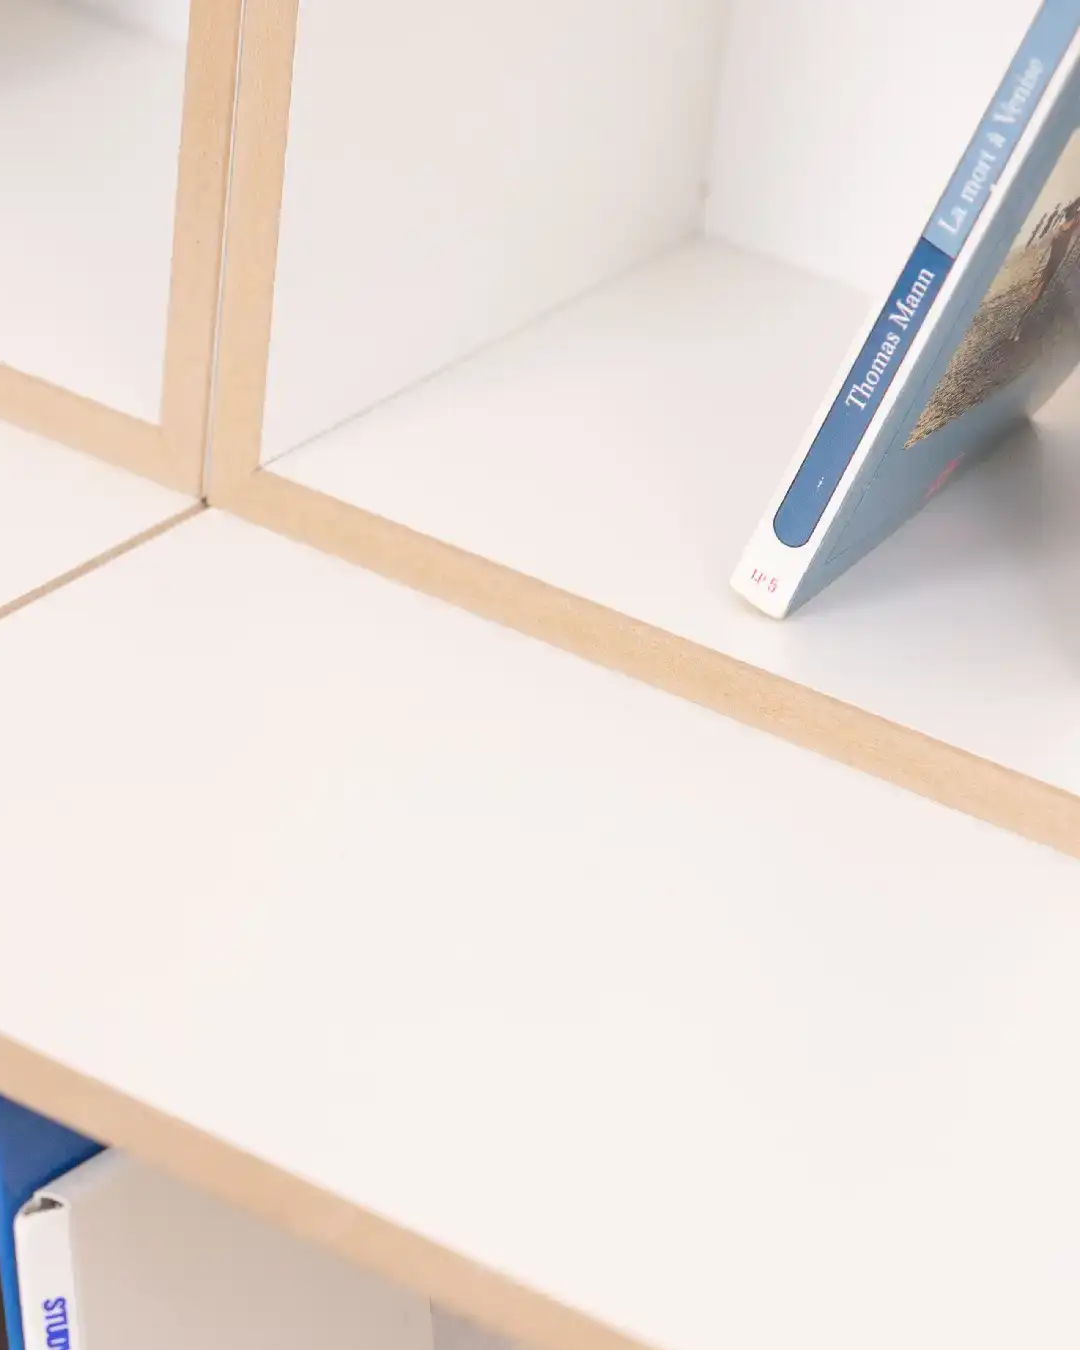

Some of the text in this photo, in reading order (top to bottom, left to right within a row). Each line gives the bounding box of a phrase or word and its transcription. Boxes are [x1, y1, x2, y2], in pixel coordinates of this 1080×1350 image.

[937, 205, 969, 235] La
[960, 149, 997, 204] mort
[992, 57, 1044, 124] Venise
[845, 267, 936, 411] Thomas Mann
